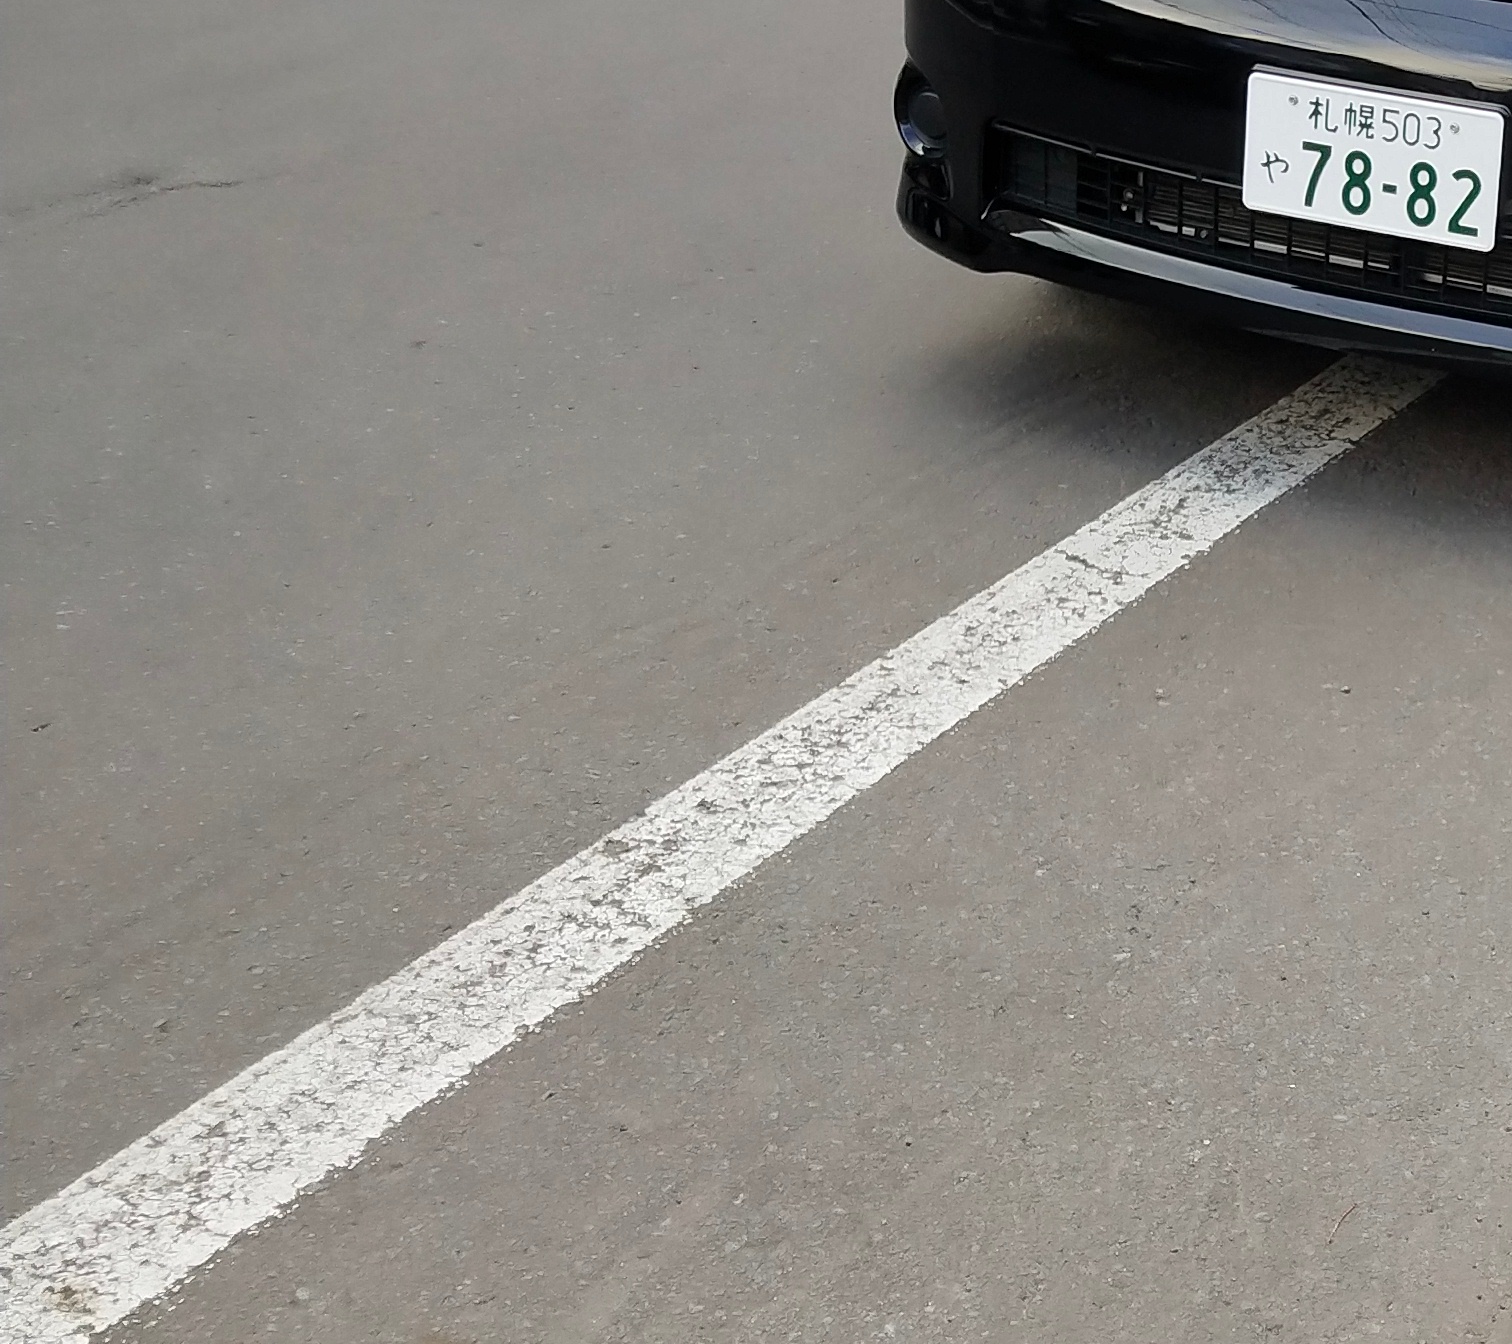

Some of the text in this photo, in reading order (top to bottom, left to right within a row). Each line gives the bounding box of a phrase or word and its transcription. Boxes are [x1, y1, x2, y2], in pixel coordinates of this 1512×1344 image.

[1307, 95, 1442, 150] 札幌503
[1260, 140, 1482, 238] や 78-82
